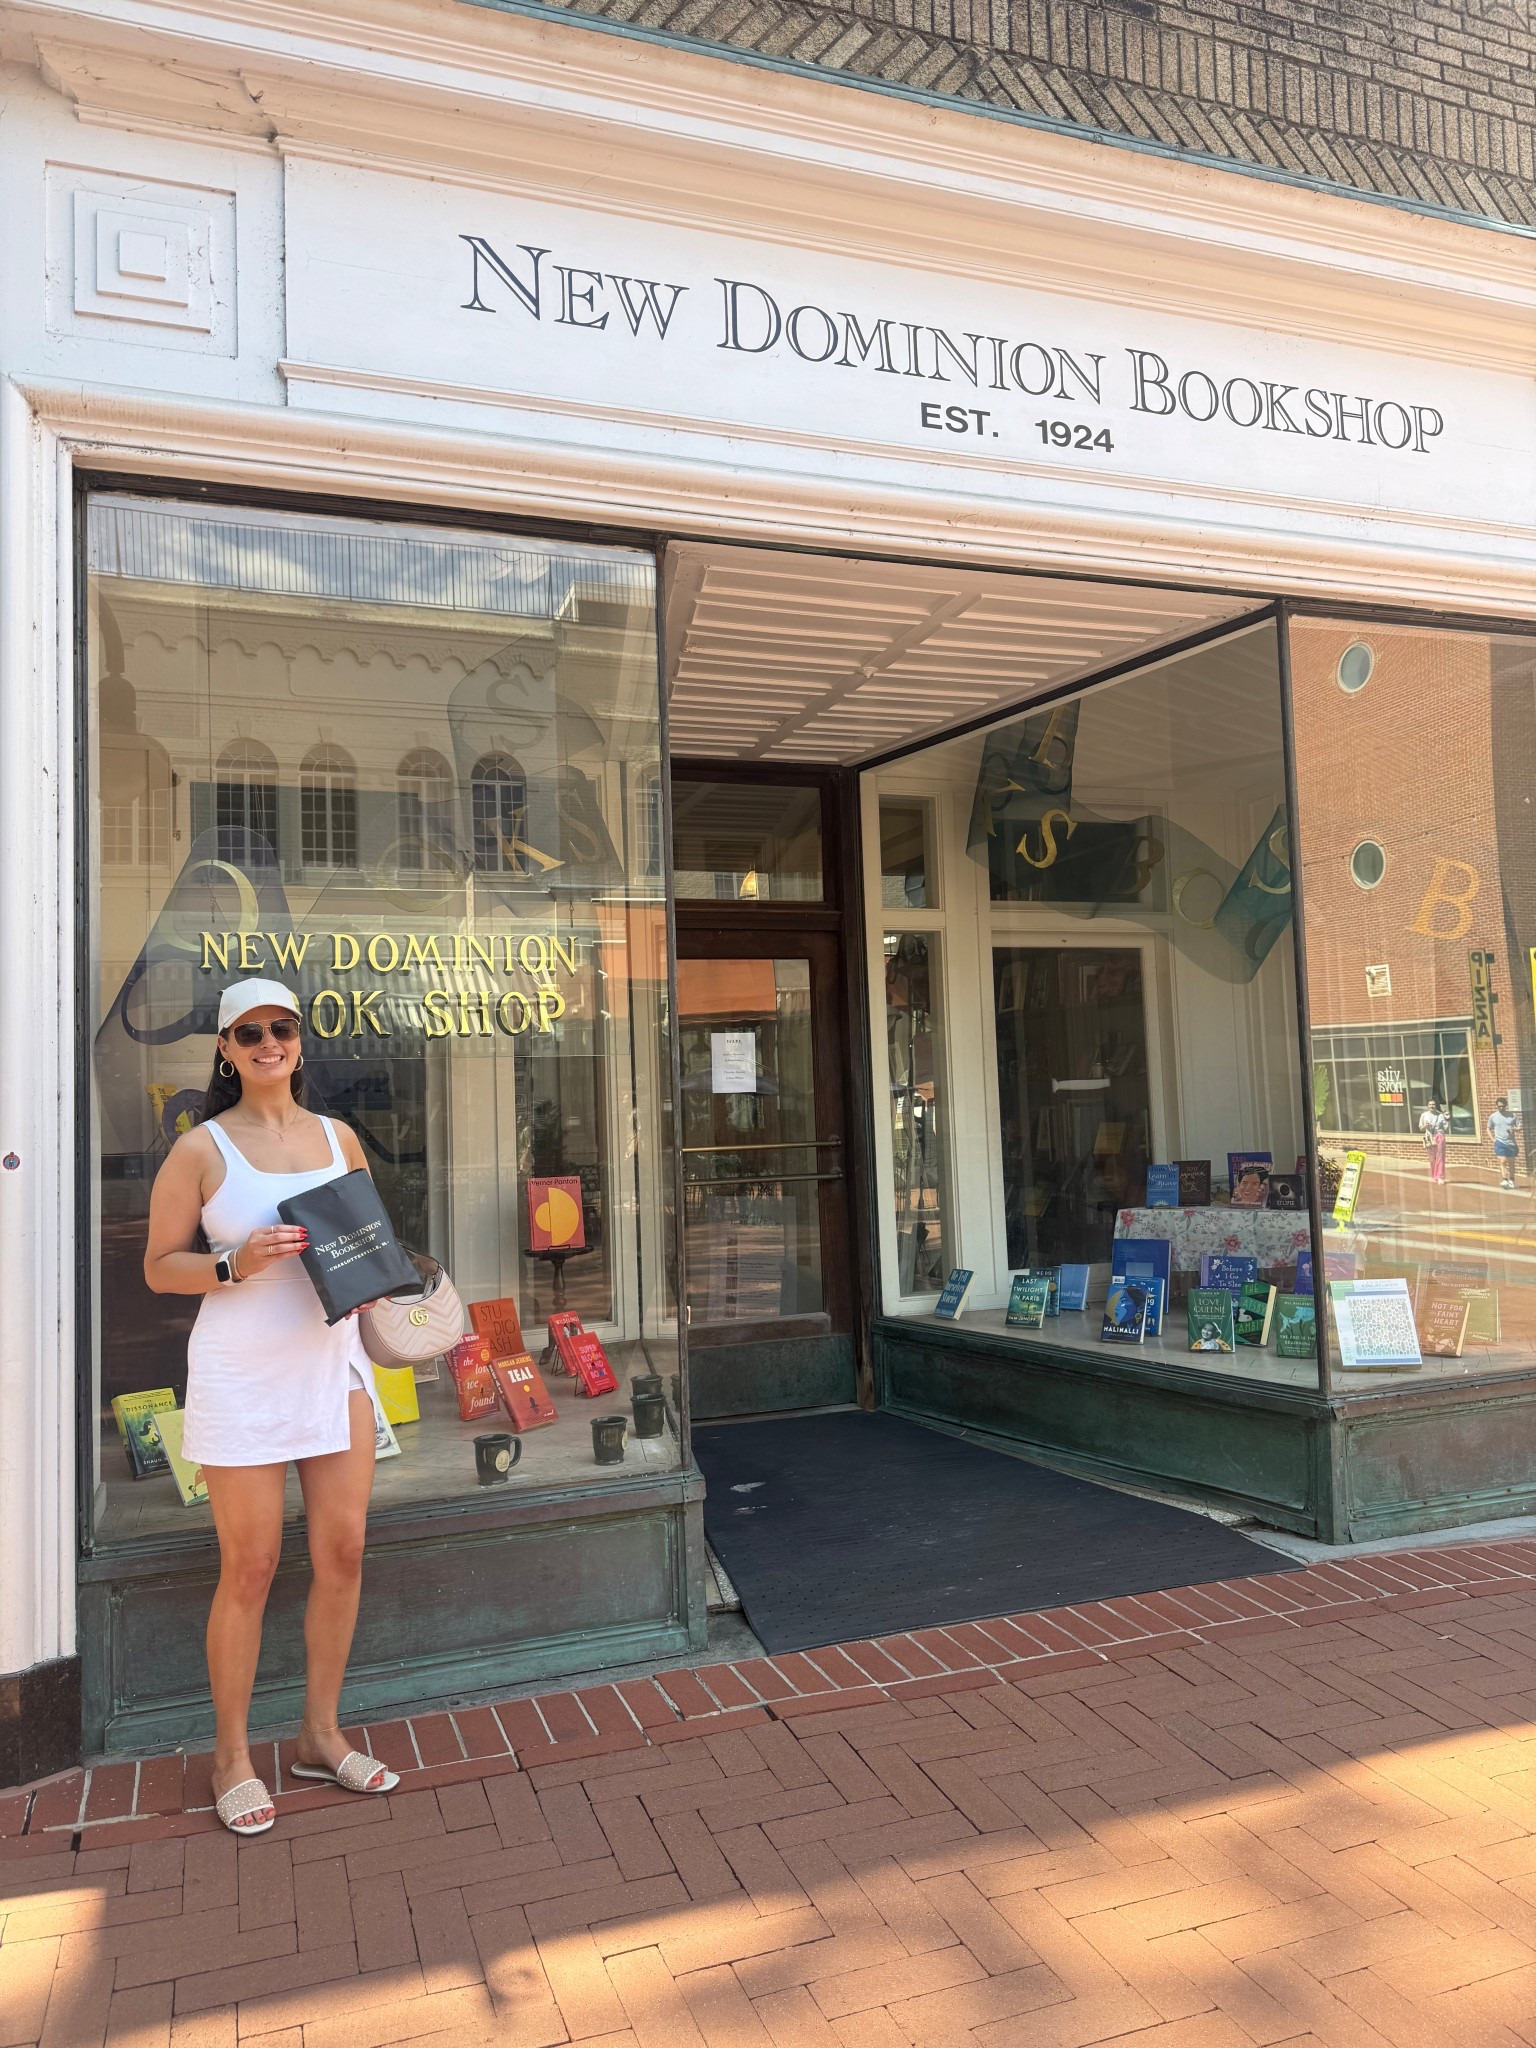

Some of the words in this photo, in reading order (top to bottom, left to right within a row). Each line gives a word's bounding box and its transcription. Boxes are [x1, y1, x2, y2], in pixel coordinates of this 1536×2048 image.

[459, 234, 690, 341] NEW
[713, 278, 1106, 405] DOMINION
[1125, 347, 1444, 454] BOOKSHOP
[920, 402, 1000, 439] EST.
[1034, 419, 1115, 453] 1924
[199, 930, 316, 975] NEW
[330, 932, 579, 978] DOMINION
[290, 988, 392, 1040] OK
[423, 988, 567, 1040] SHOP
[315, 1241, 337, 1256] NEW
[338, 1220, 382, 1245] DOMINION
[330, 1233, 376, 1259] BOOKSHOP
[1228, 1280, 1241, 1288] Slee
[1245, 1284, 1259, 1294] THE
[480, 1305, 502, 1321] STU
[1193, 1305, 1226, 1314] QUEENIE
[1431, 1301, 1447, 1310] NOT
[1450, 1304, 1464, 1312] FOR
[1436, 1310, 1460, 1318] FAINT
[493, 1319, 516, 1336] DIO
[1433, 1318, 1459, 1326] HEART
[579, 1344, 598, 1354] SUPER
[463, 1357, 474, 1367] the
[475, 1364, 489, 1375] lov
[507, 1366, 534, 1383] ZEAL
[466, 1380, 479, 1390] we
[126, 1400, 173, 1413] DISSONANCE
[469, 1392, 495, 1413] found
